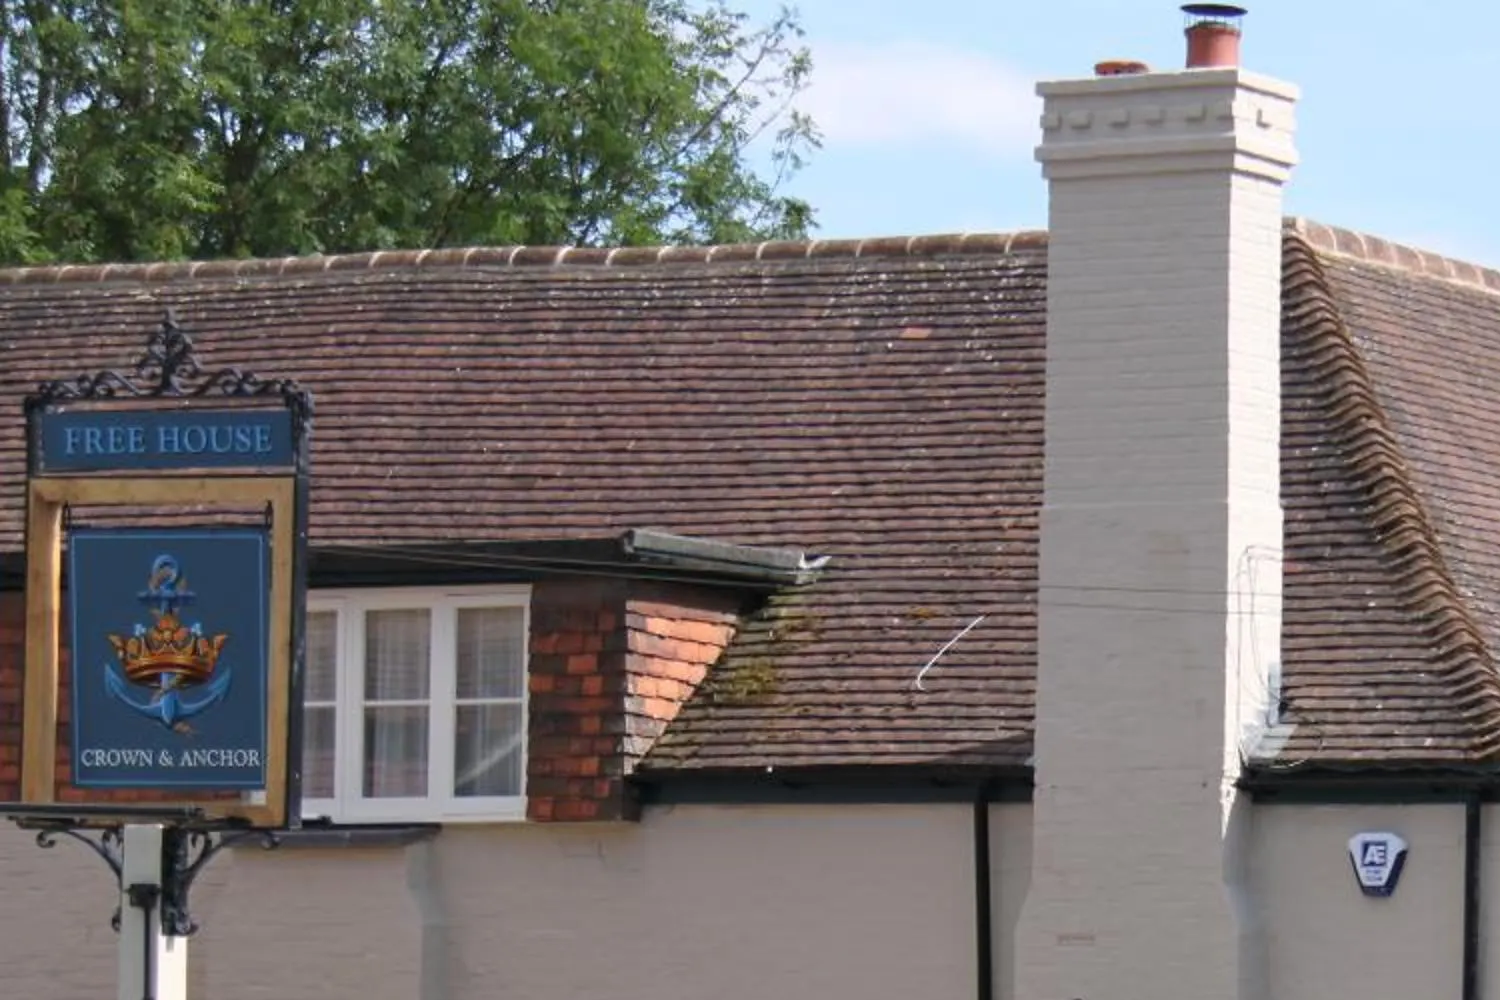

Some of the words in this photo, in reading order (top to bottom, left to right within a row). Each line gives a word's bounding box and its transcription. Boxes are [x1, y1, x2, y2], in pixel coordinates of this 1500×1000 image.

[65, 427, 146, 455] FREE
[158, 425, 273, 453] HOUSE
[81, 749, 154, 767] CROWN
[158, 750, 174, 767] &
[178, 749, 261, 768] ANCHOR
